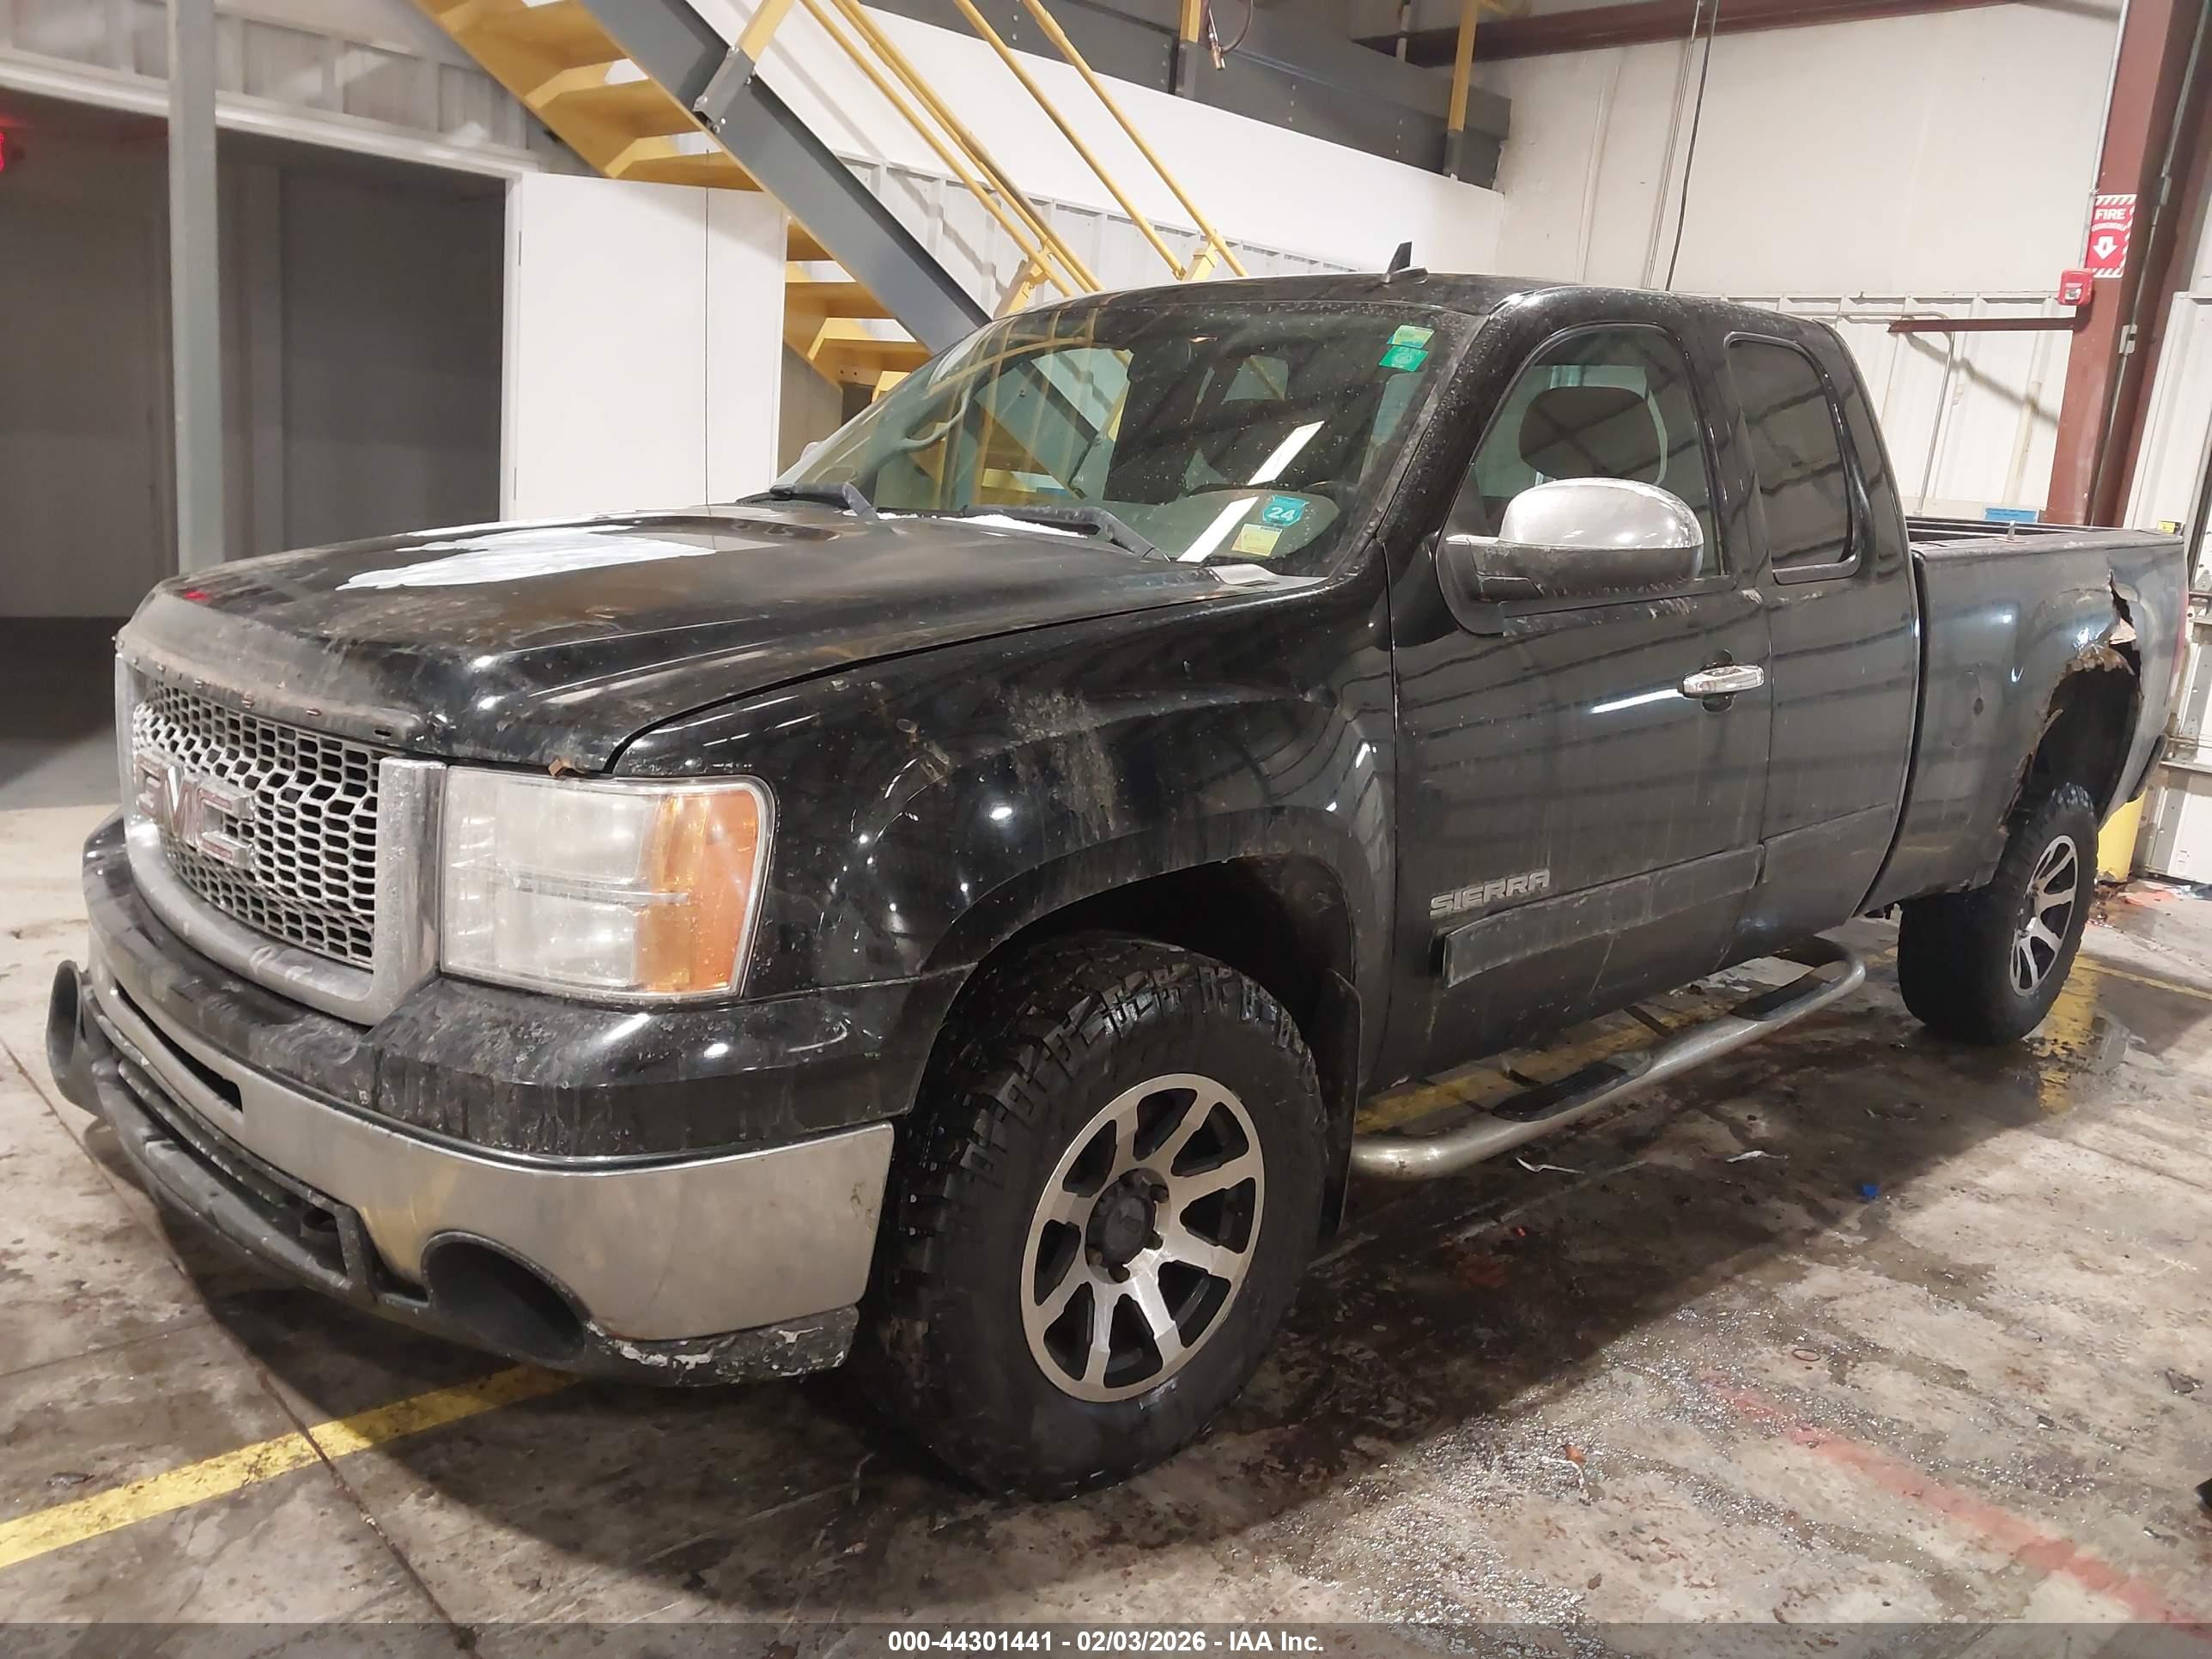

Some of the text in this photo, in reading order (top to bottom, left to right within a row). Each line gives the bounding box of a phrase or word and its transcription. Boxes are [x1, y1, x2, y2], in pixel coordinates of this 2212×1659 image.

[2095, 208, 2127, 221] FIRE
[1267, 507, 1296, 521] 24
[1429, 867, 1550, 921] SIERRA
